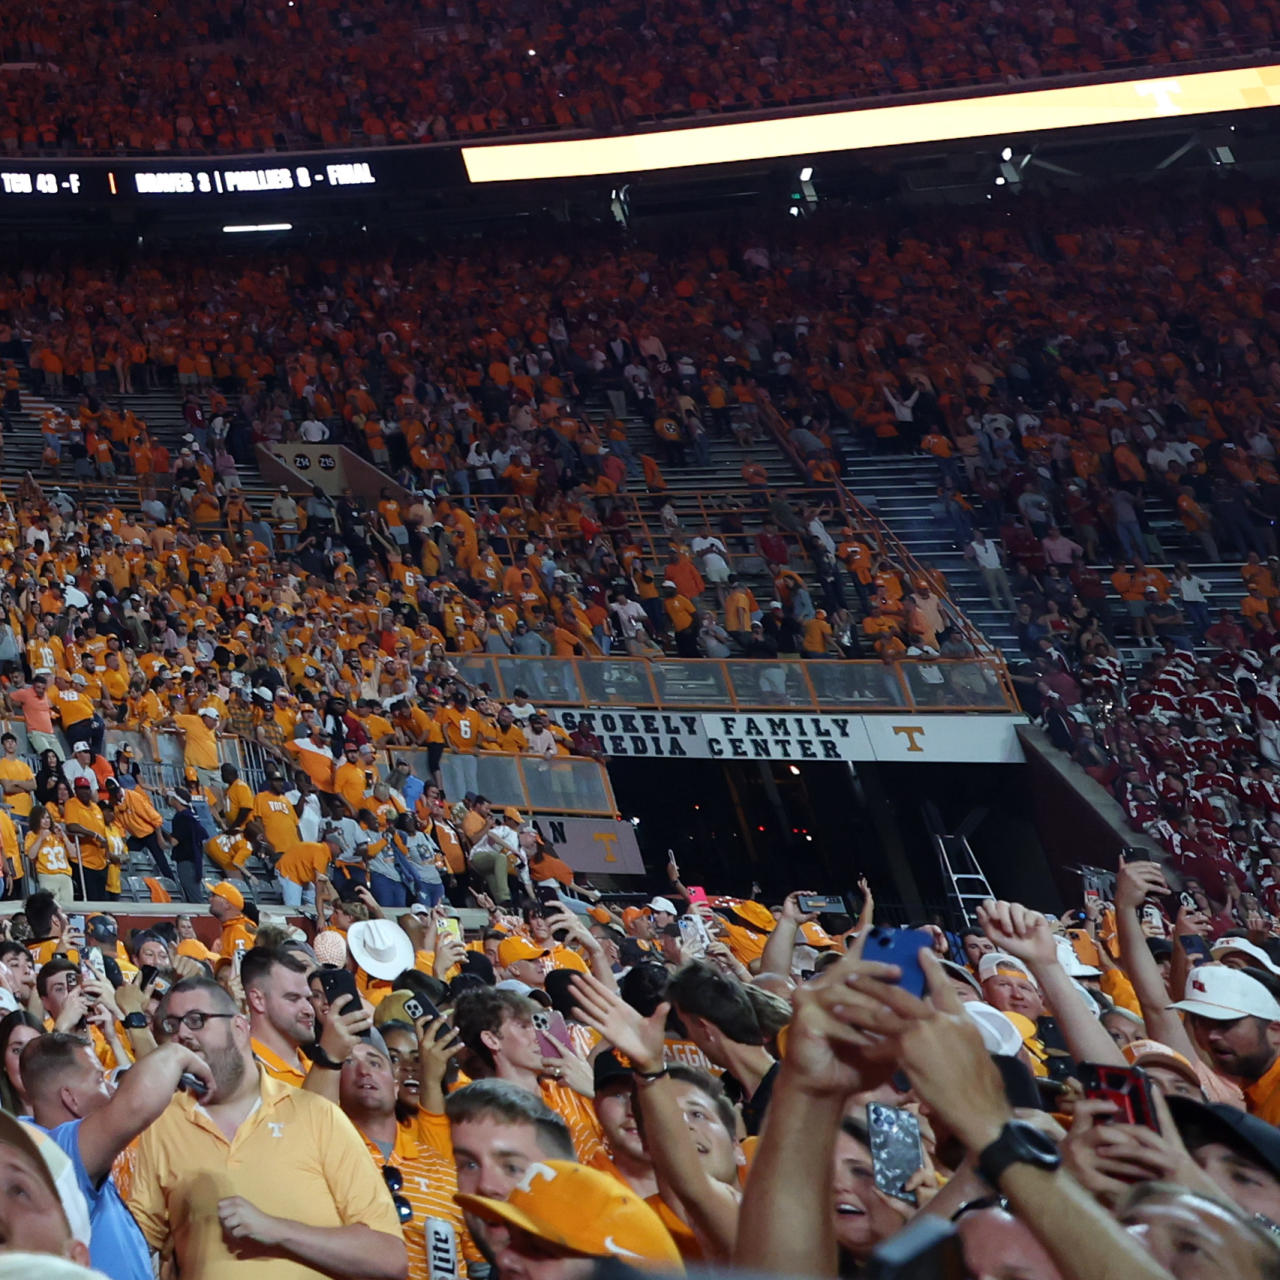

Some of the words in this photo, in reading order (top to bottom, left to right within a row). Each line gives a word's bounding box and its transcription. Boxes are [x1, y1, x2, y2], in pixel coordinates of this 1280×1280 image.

[1, 173, 32, 193] TCU
[224, 169, 294, 192] PHILLIES
[326, 163, 376, 186] FINAL
[405, 572, 414, 586] 6
[460, 721, 472, 739] 6
[561, 712, 697, 736] STOKELY
[720, 716, 850, 738] FAMILY
[707, 737, 841, 759] CENTER
[892, 726, 925, 752] T
[43, 846, 67, 870] 33
[268, 1122, 284, 1137] T
[432, 1229, 456, 1275] Lite
